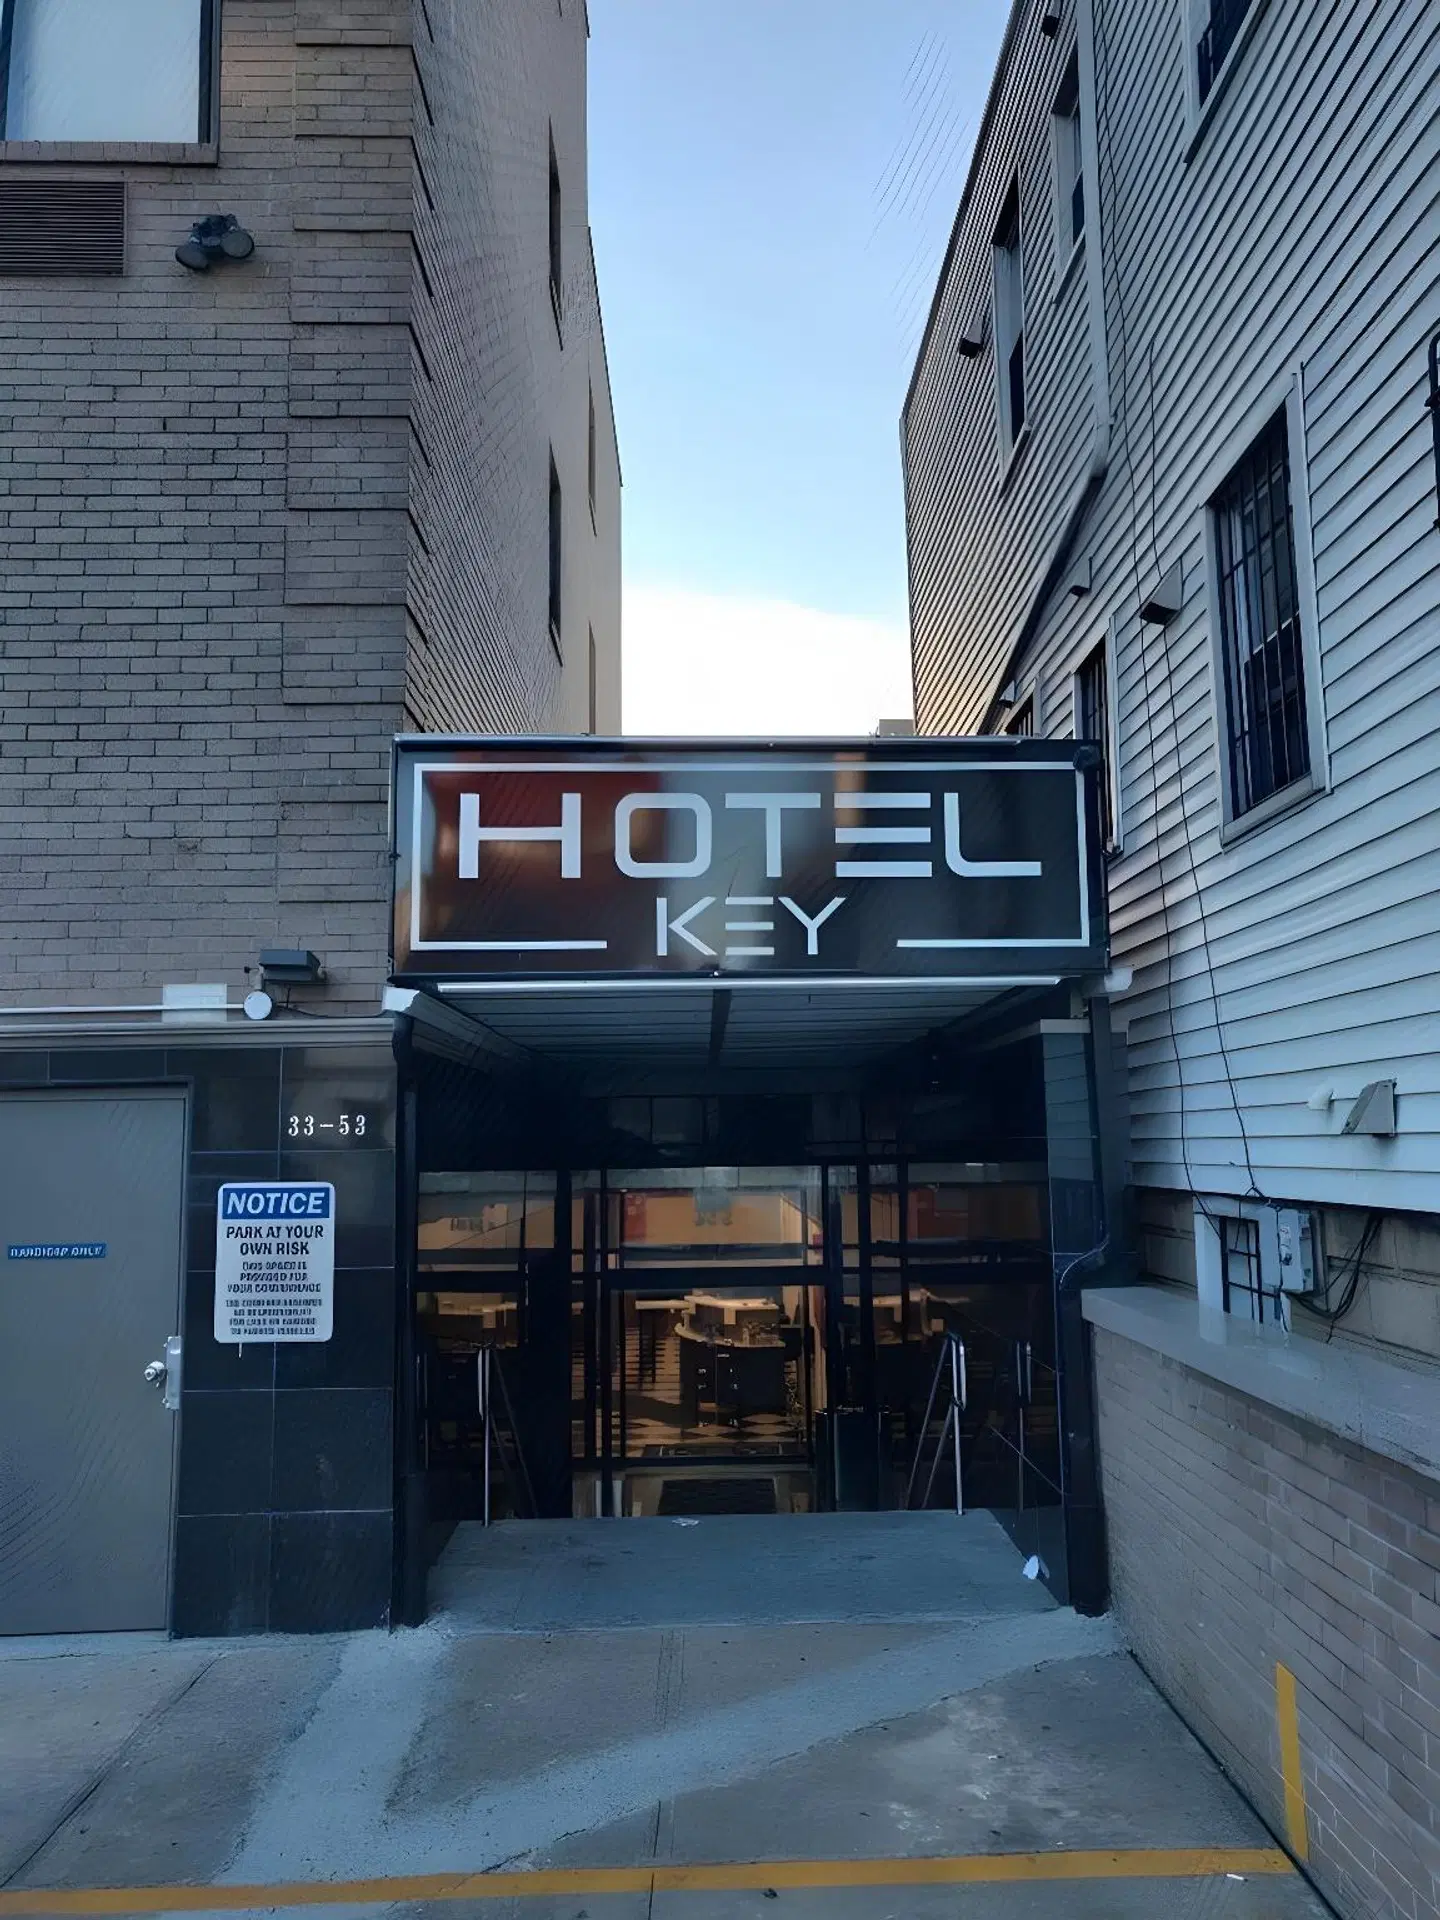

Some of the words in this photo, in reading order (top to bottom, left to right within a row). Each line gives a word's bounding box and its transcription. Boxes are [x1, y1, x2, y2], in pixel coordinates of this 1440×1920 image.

[458, 792, 1042, 879] HOTEL
[656, 896, 846, 957] KEY
[288, 1114, 366, 1137] 33-53
[227, 1191, 325, 1215] NOTICE
[226, 1226, 263, 1239] PARK
[266, 1226, 281, 1238] AT
[285, 1225, 324, 1238] YOUR
[240, 1242, 273, 1256] OWN
[276, 1241, 310, 1255] RISK
